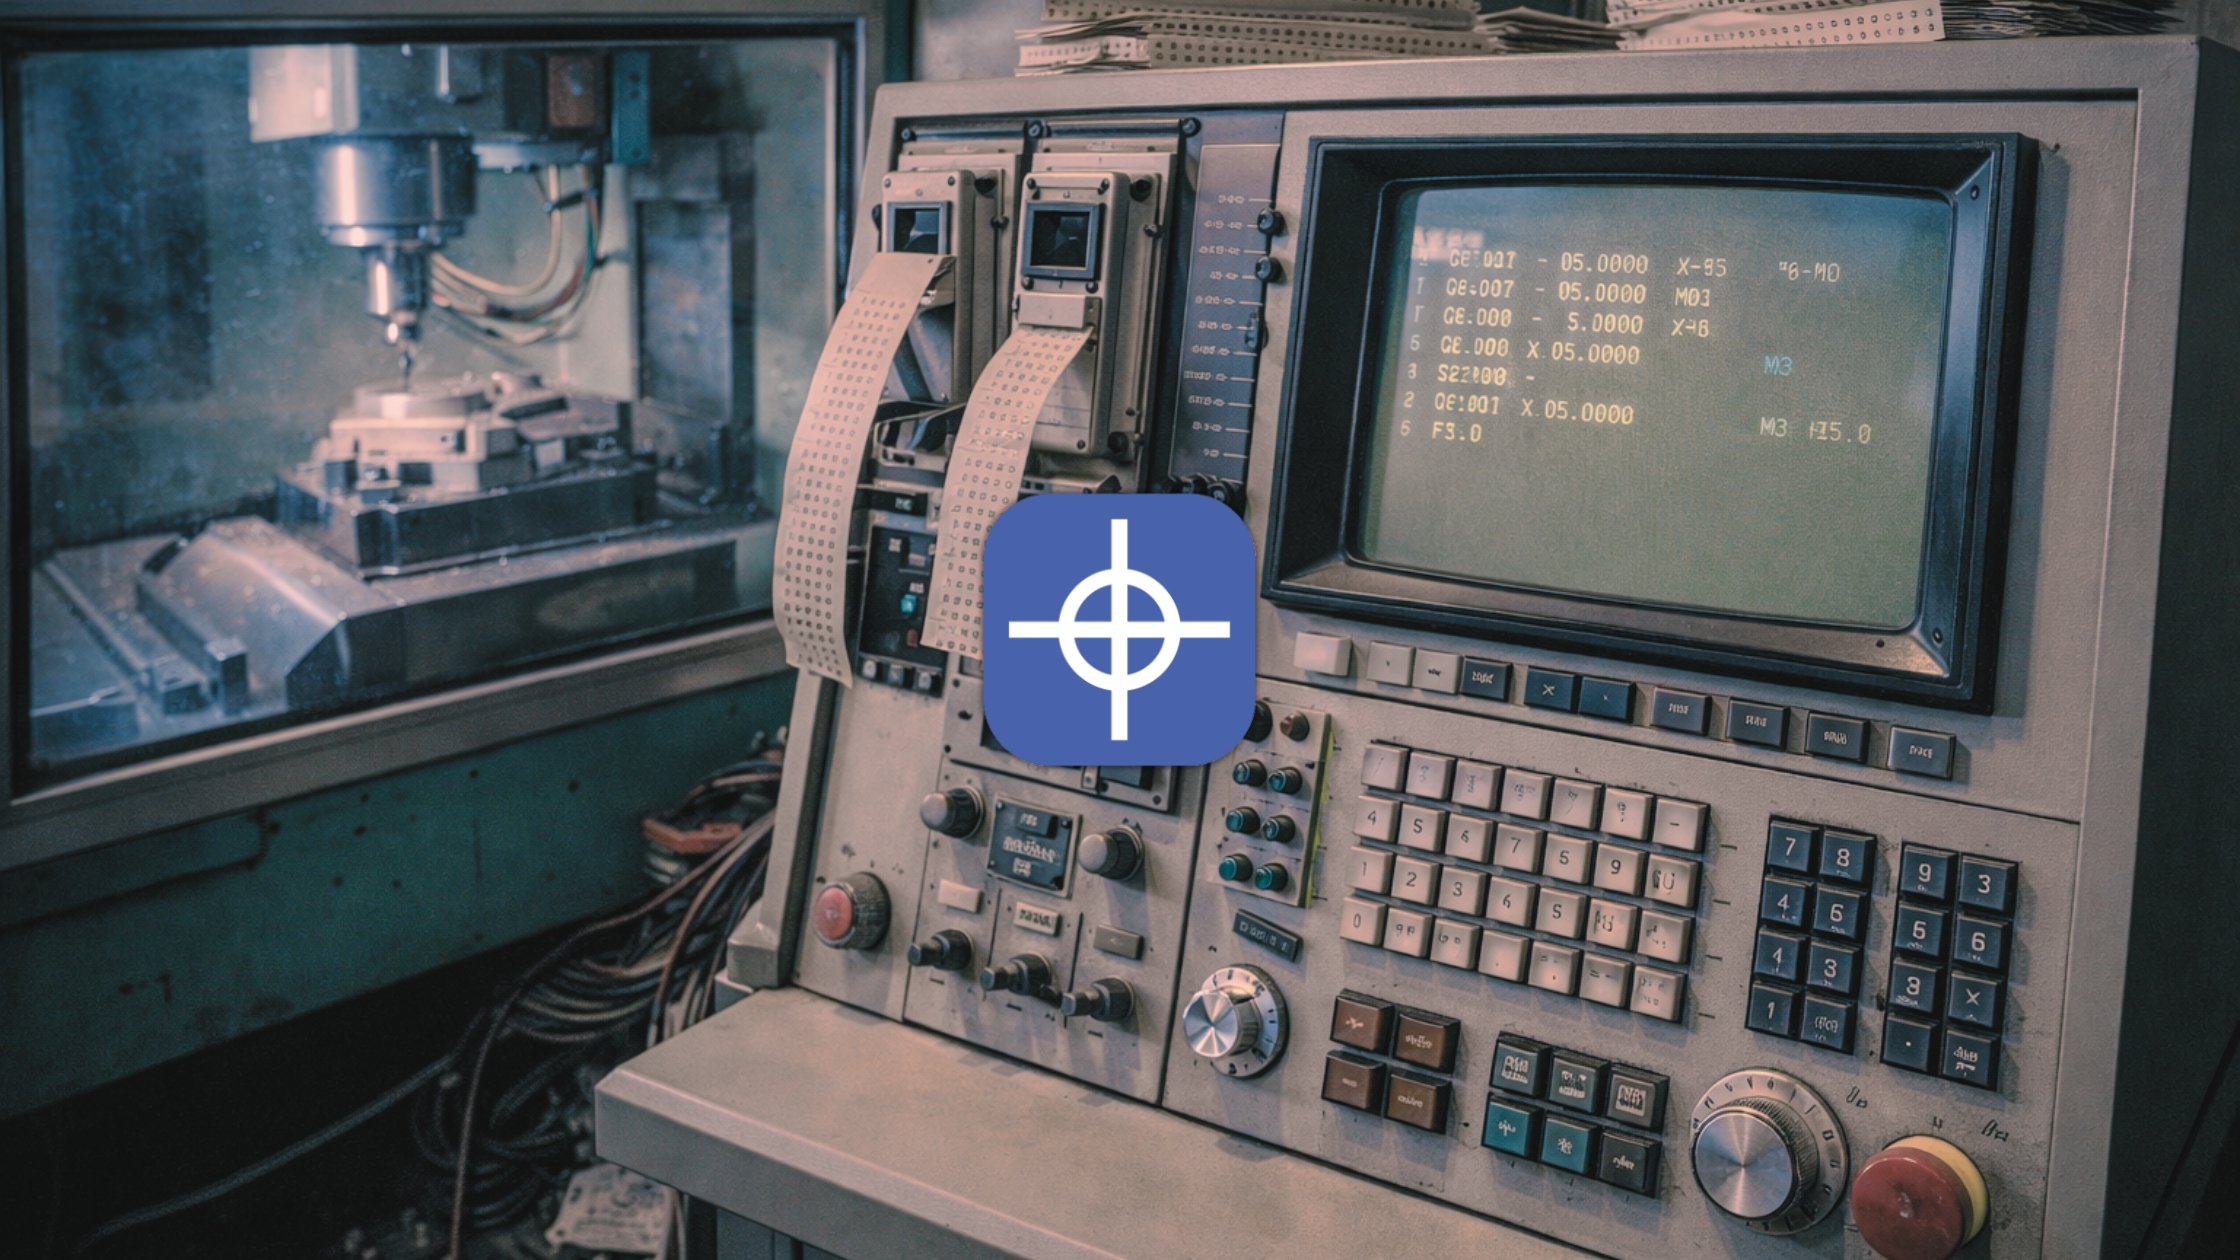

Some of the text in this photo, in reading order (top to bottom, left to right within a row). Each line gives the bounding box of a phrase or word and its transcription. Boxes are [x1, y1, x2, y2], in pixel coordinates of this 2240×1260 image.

[1561, 252, 1649, 274] 05.0000
[1558, 281, 1647, 304] 05.0000
[1764, 356, 1793, 376] M3
[1760, 417, 1788, 437] M3
[1367, 811, 1377, 825] 4
[1511, 837, 1521, 854] 7
[1785, 837, 1797, 856] 7
[1836, 848, 1850, 867] 8
[1362, 861, 1368, 877] 1
[1611, 860, 1621, 875] 9
[1918, 863, 1932, 883] 9
[1406, 871, 1417, 888] 2
[1977, 874, 1991, 894] 3
[1452, 882, 1463, 897] 3
[1503, 894, 1511, 908] 6
[1777, 894, 1788, 911] 4
[1829, 903, 1843, 922] 6
[1971, 932, 1986, 951] 6
[1823, 958, 1837, 978] 3
[1767, 1001, 1775, 1020] 1
